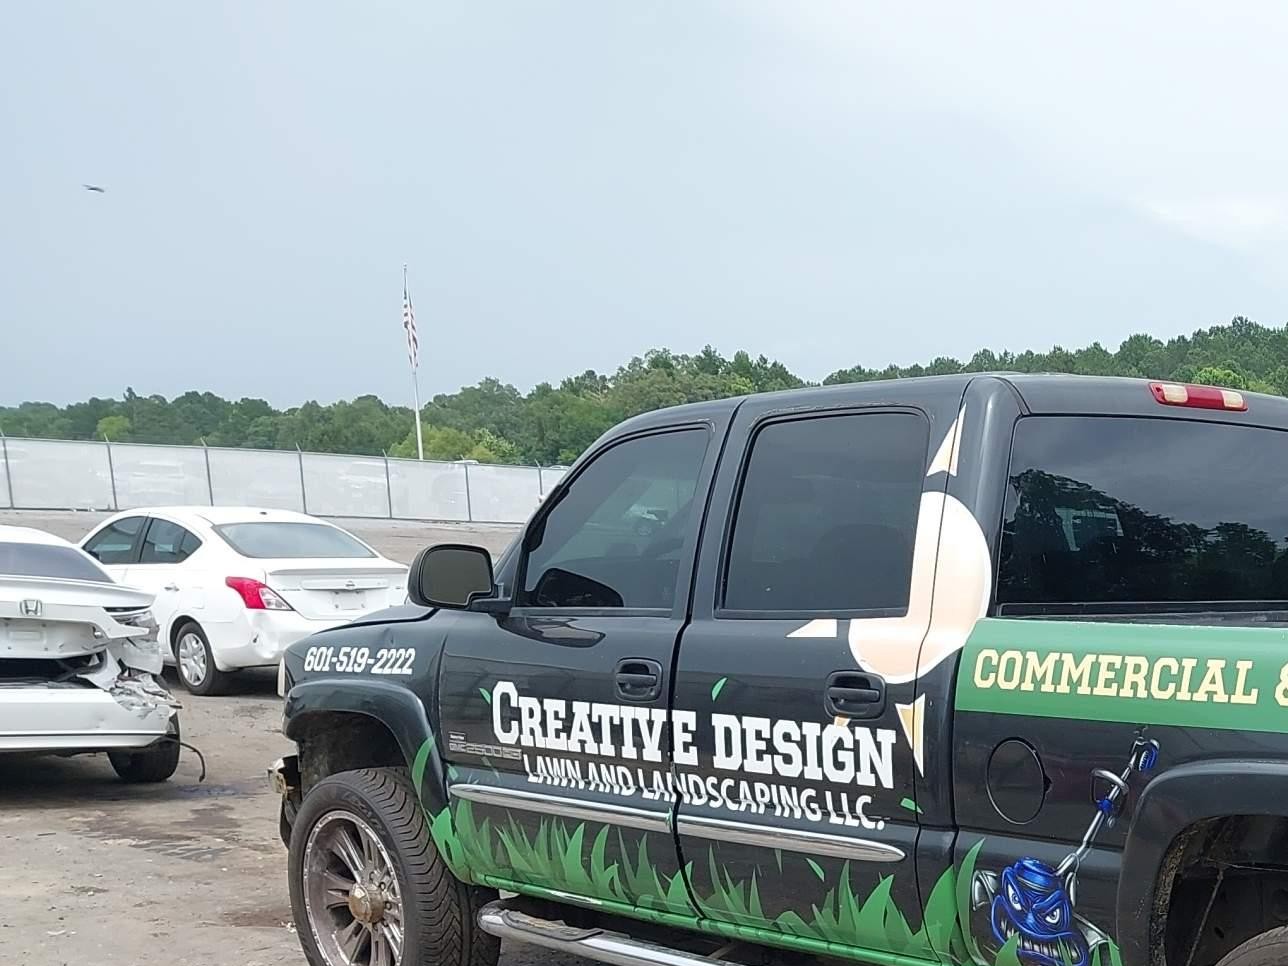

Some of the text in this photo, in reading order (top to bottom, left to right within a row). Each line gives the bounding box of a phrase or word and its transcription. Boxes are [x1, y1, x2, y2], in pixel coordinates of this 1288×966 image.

[304, 646, 416, 675] 601-519-2222
[973, 649, 1259, 704] COMMERCIAL
[492, 681, 897, 789] CREATIVE DESIGN
[523, 754, 886, 831] LAWN AND LANDSCAPING LLC.
